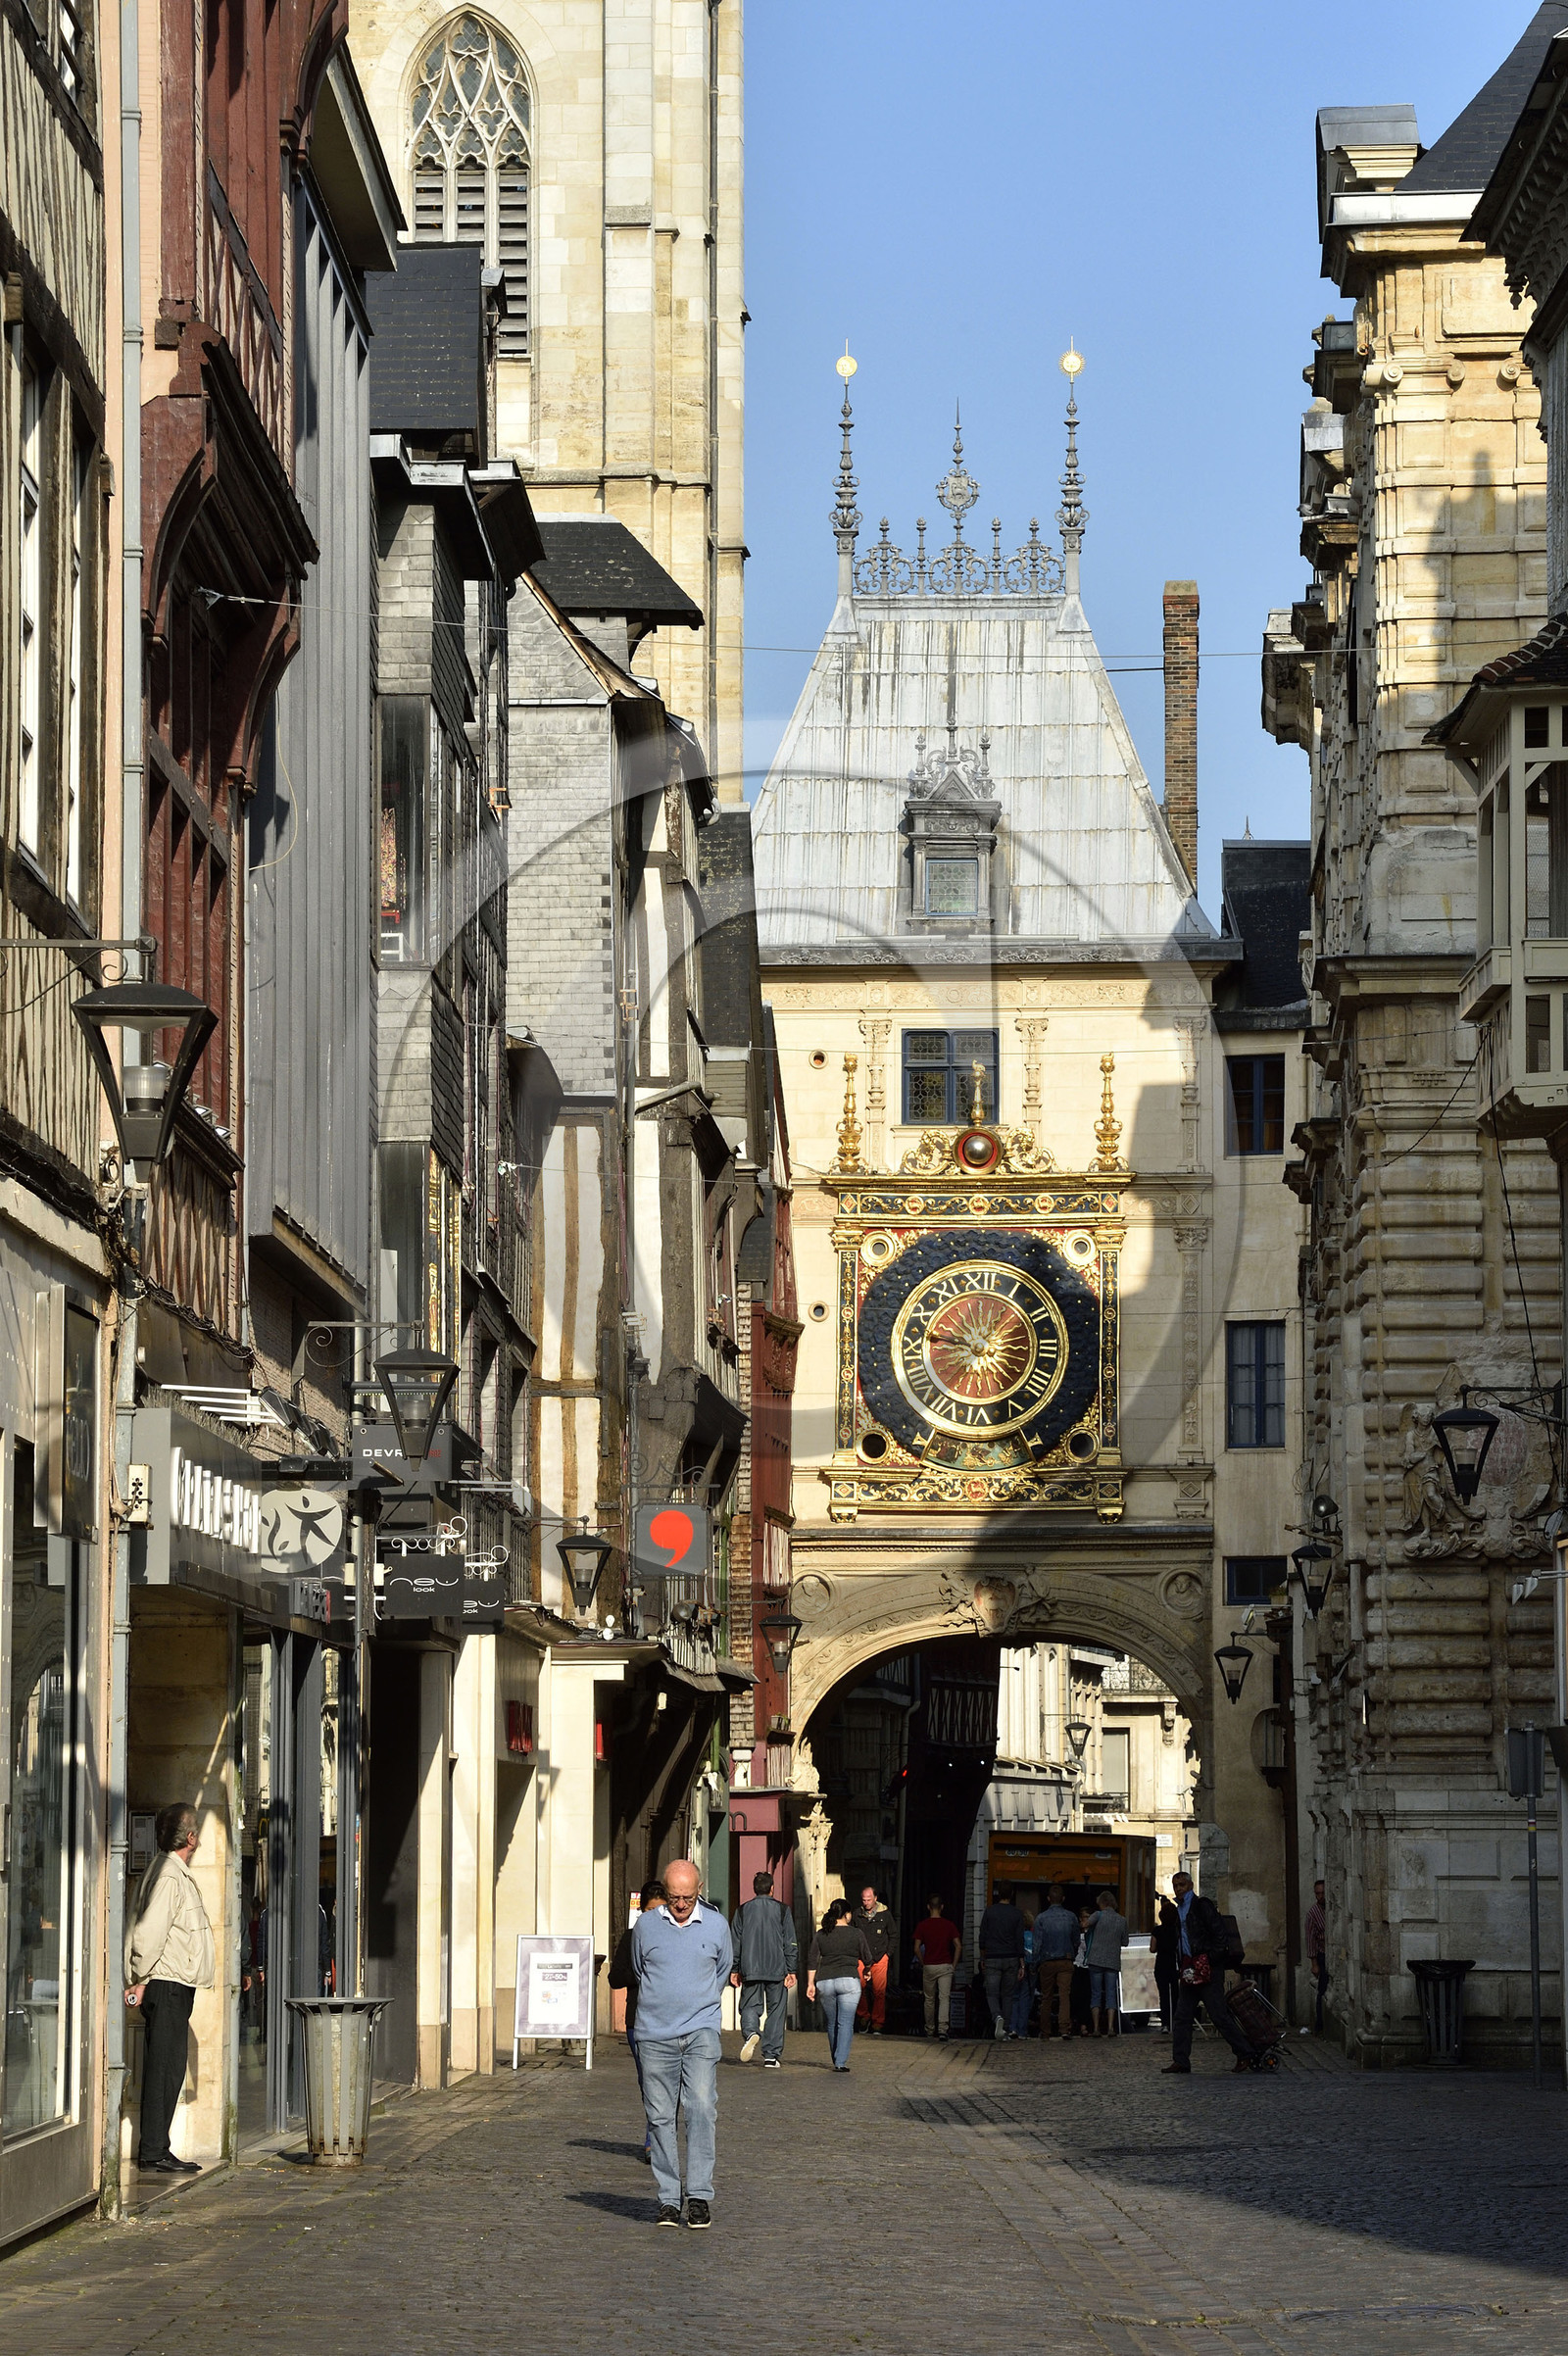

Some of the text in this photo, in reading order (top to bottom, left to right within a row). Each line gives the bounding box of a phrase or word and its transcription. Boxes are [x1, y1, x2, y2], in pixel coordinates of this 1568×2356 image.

[932, 1277, 960, 1304] XI
[964, 1272, 997, 1291] XII
[1007, 1282, 1022, 1300] I
[911, 1302, 934, 1326] X
[1029, 1306, 1050, 1326] II
[903, 1336, 922, 1363] IX
[1039, 1339, 1057, 1359] III
[1025, 1368, 1052, 1398] IIII
[930, 1395, 957, 1420] VII
[965, 1405, 993, 1425] VI
[1007, 1399, 1024, 1418] V
[363, 1448, 403, 1457] DEVR
[389, 1577, 459, 1587] new
[464, 1599, 500, 1608] ew
